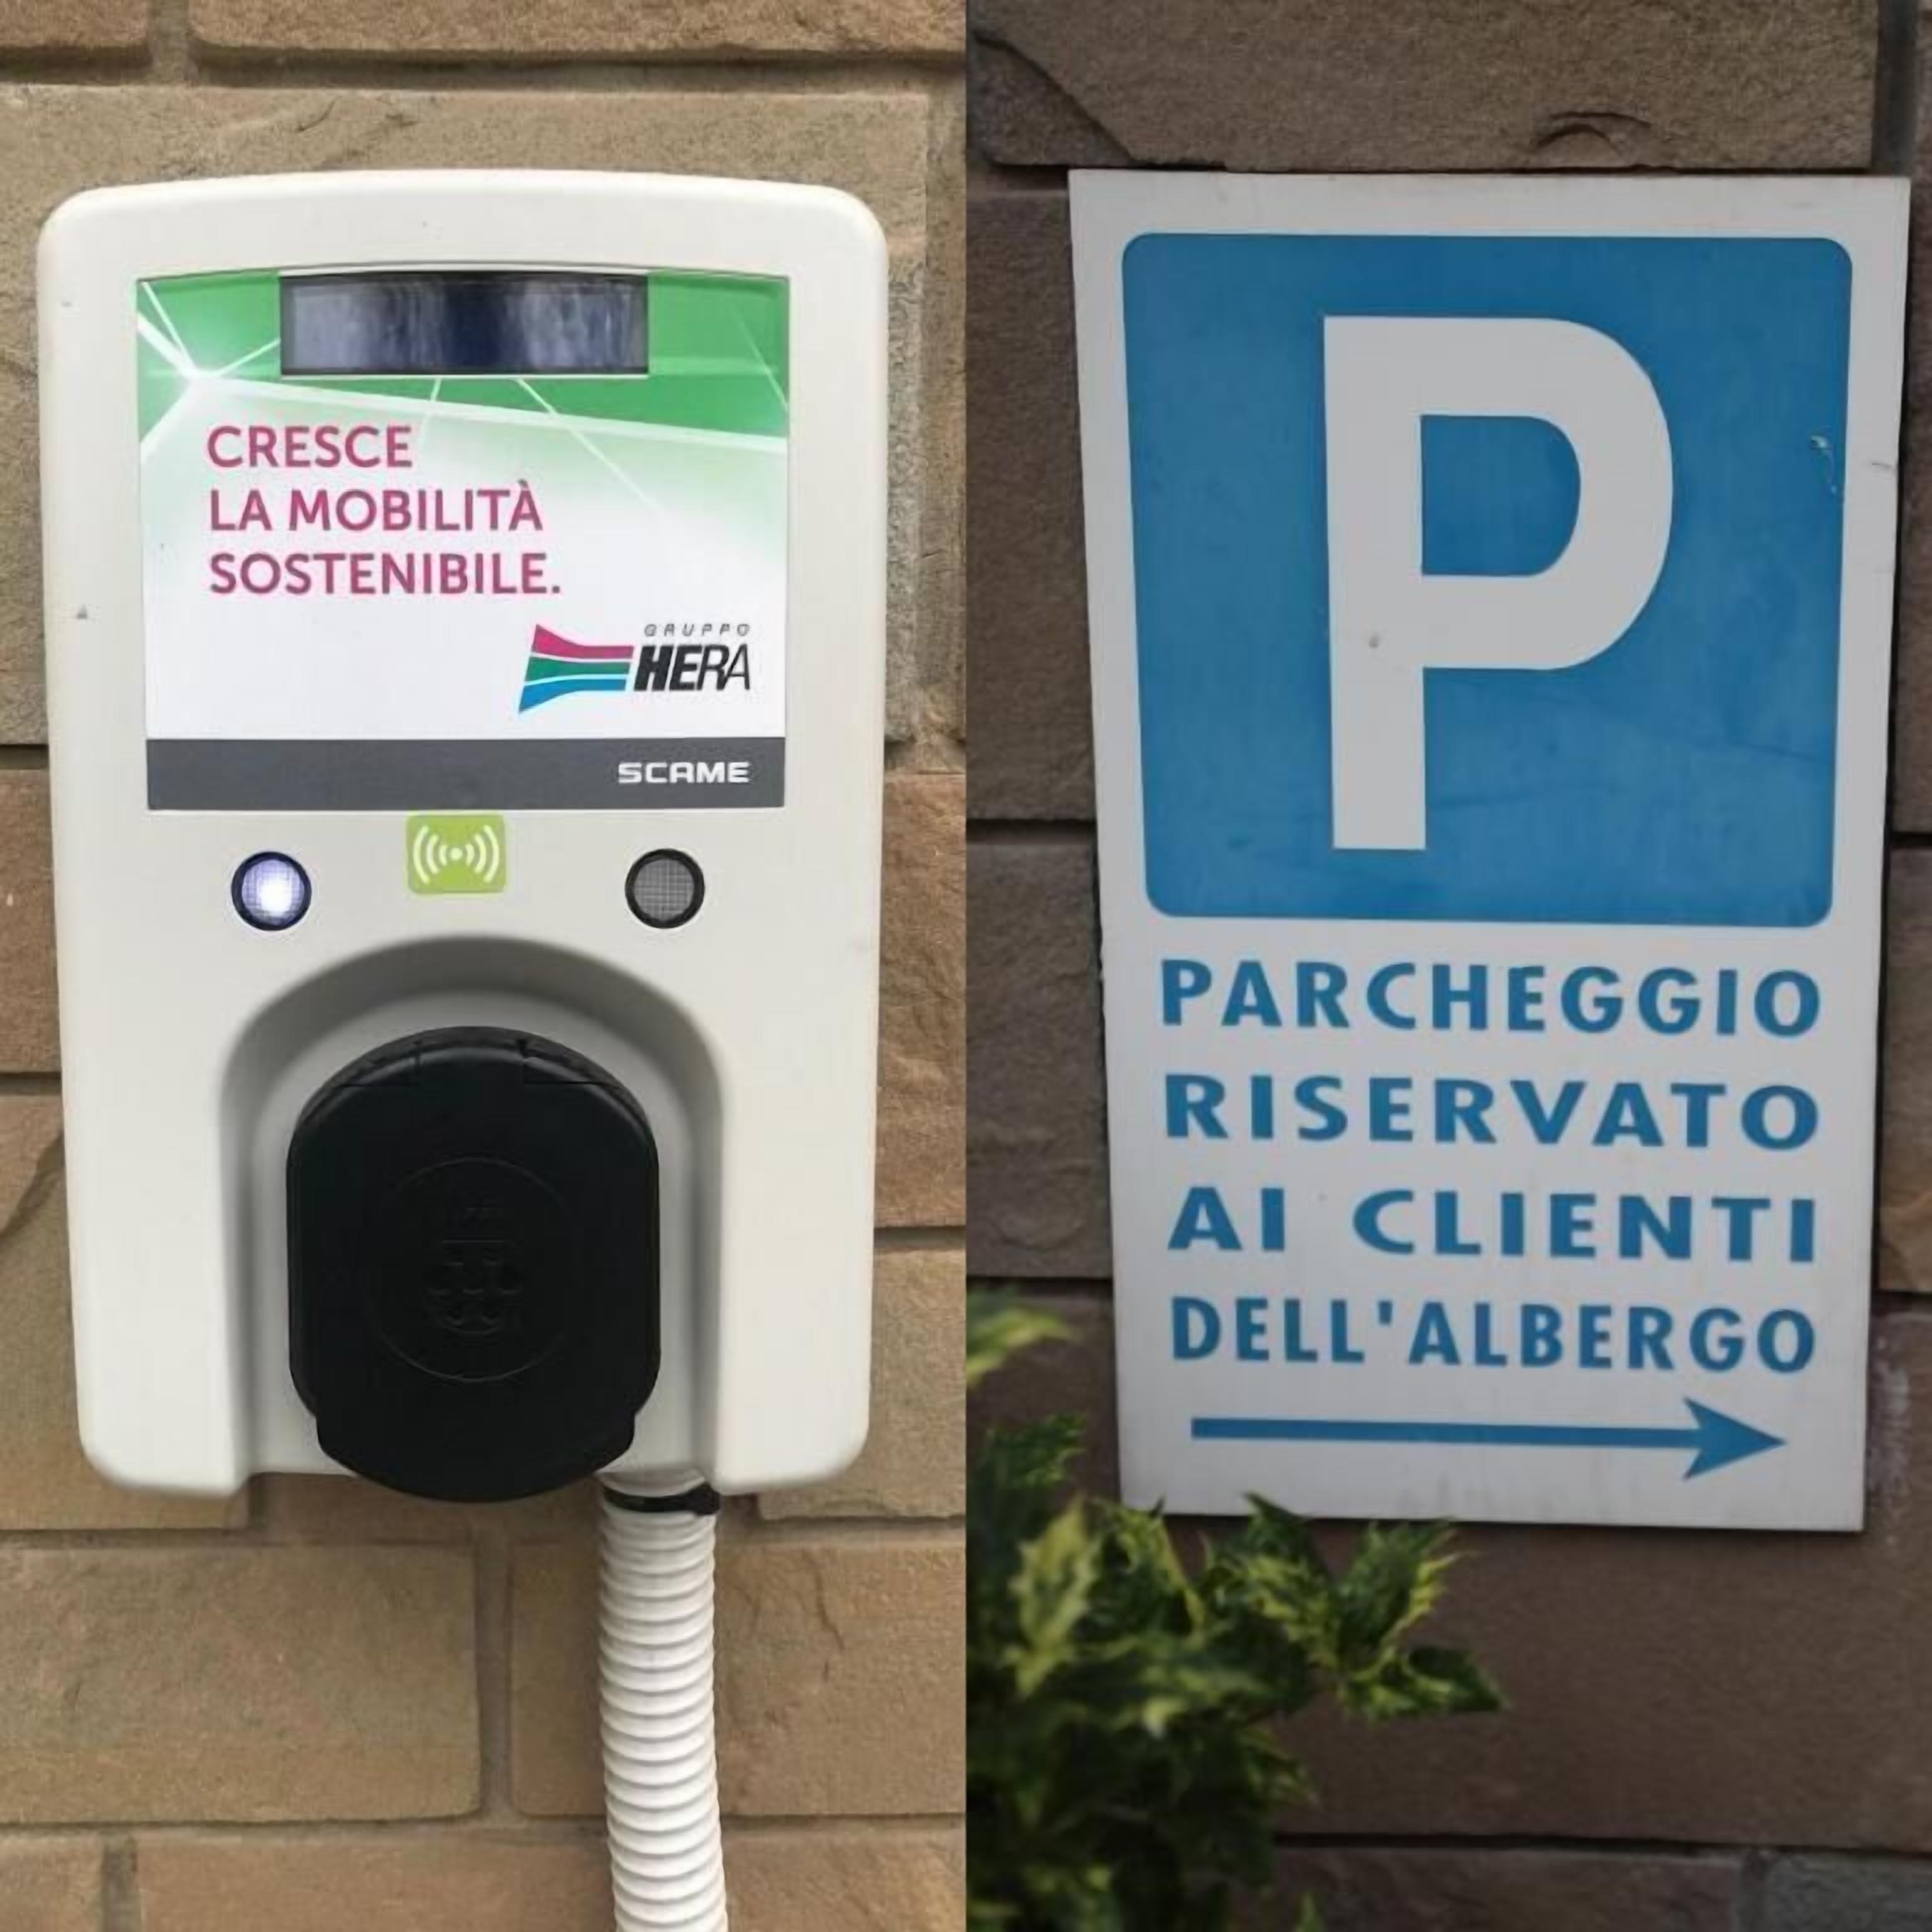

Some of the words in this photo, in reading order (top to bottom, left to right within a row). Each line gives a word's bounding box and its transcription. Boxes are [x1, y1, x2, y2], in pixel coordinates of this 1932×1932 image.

[207, 424, 412, 470] CRESCE
[210, 490, 274, 532] LA
[288, 480, 543, 533] MOBILITÀ
[210, 552, 561, 597] SOSTENIBILE.
[1324, 316, 1673, 851] P
[644, 623, 750, 637] GRUPPO
[634, 643, 750, 691] HERA
[618, 761, 750, 784] SCAME
[1160, 959, 1821, 1037] PARCHEGGIO
[1165, 1073, 1819, 1152] RISERVATO
[1168, 1184, 1287, 1251] AI
[1353, 1189, 1816, 1263] CLIENTI
[1172, 1296, 1814, 1374] DELL'ALBERGO
